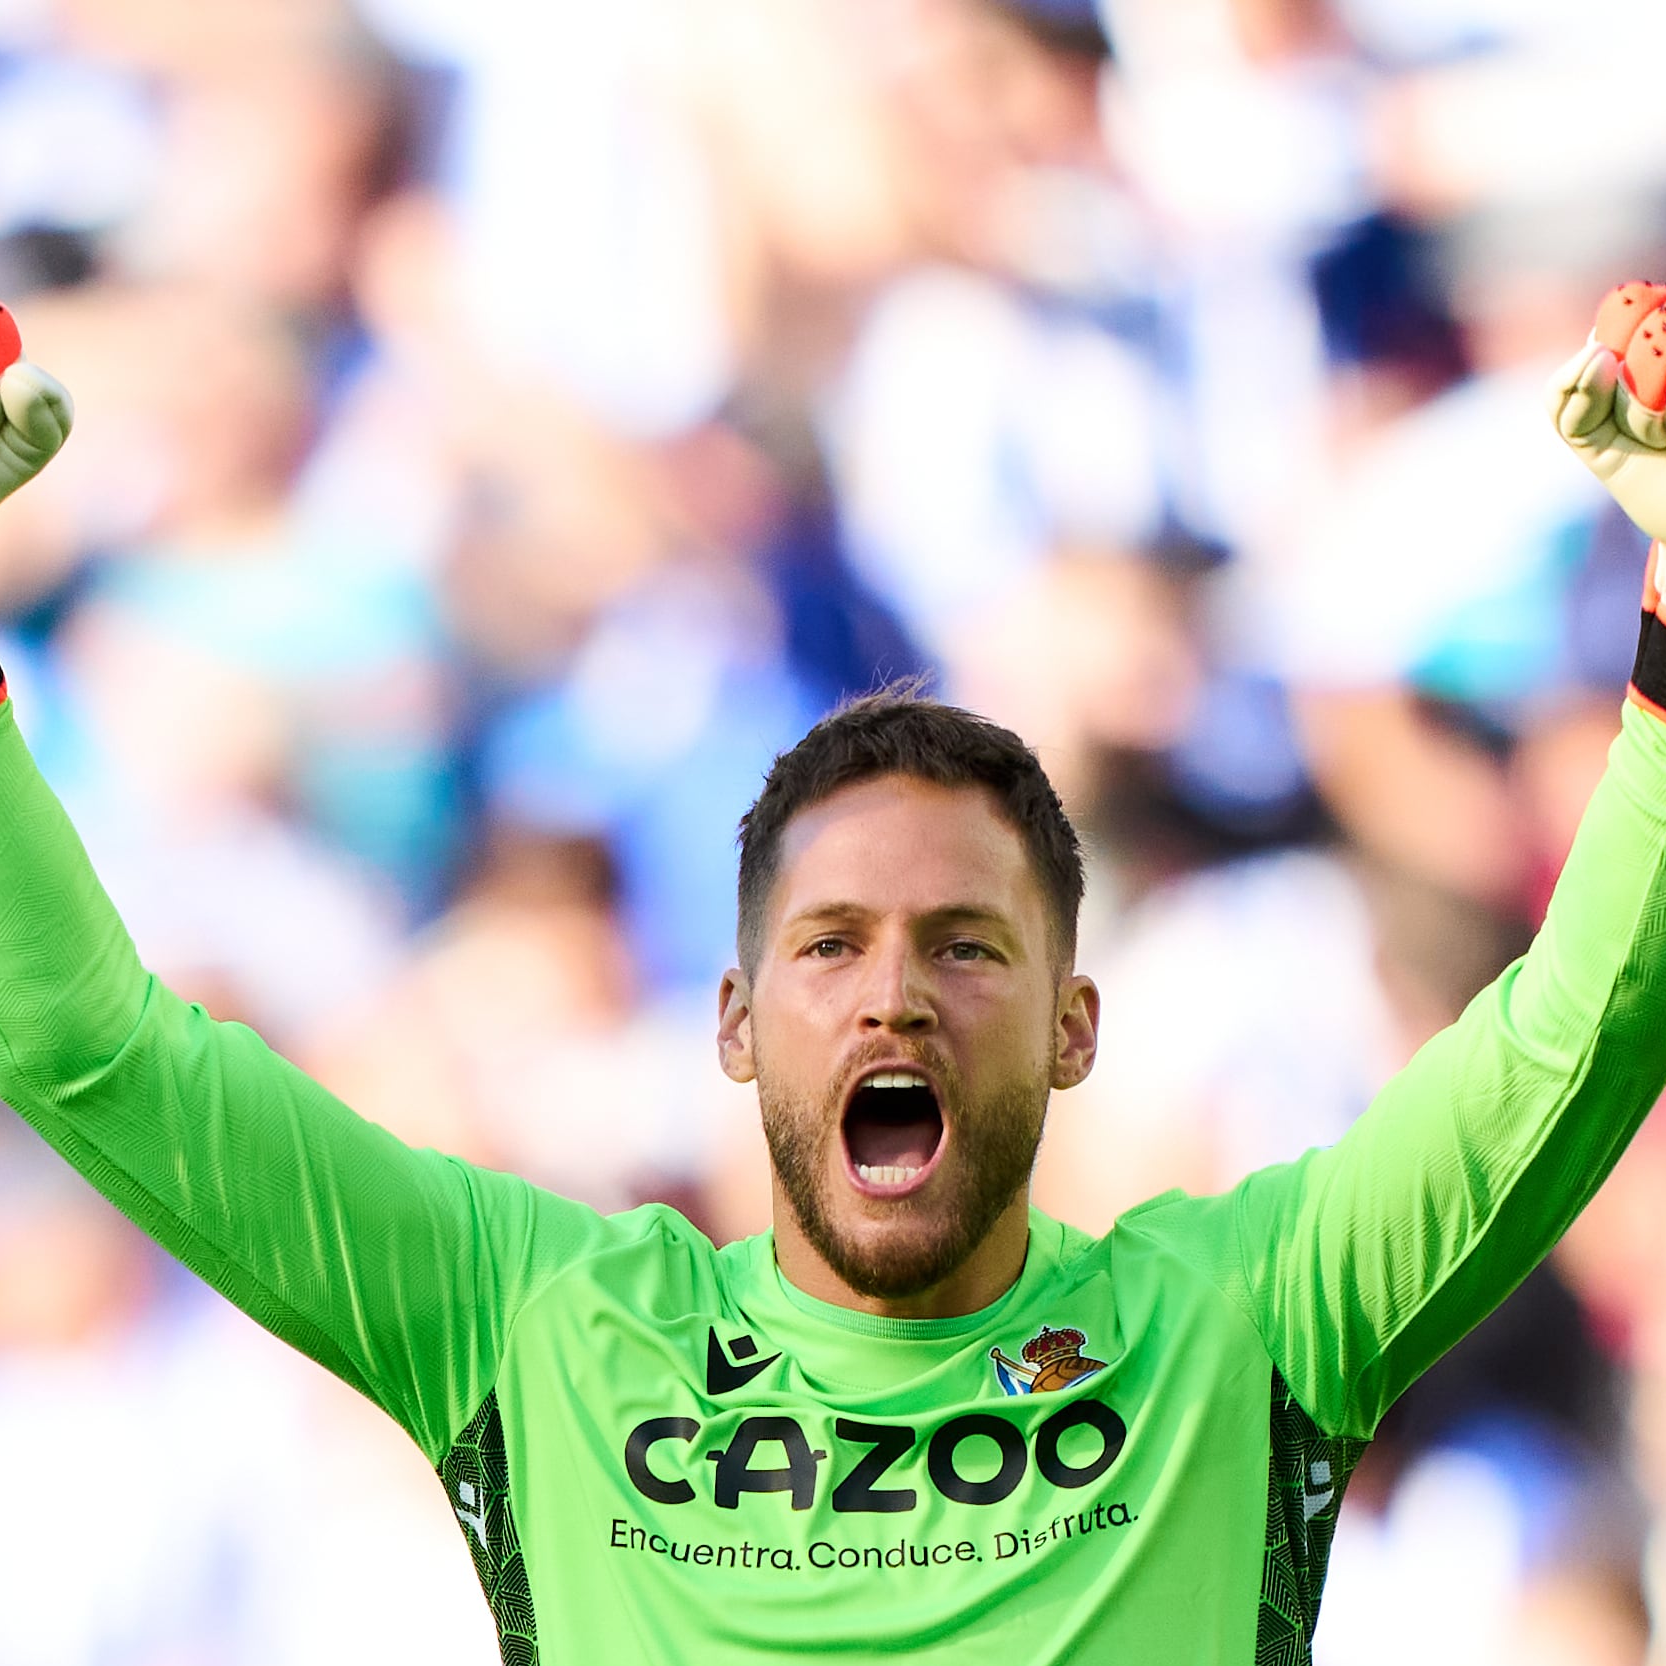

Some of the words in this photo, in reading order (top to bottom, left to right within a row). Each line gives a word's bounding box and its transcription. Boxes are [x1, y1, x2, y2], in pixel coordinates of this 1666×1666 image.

[624, 1400, 1127, 1513] CAZOO
[610, 1518, 801, 1571] Encuentra.
[808, 1540, 983, 1570] Conduce.
[994, 1500, 1140, 1560] Disfruta.
